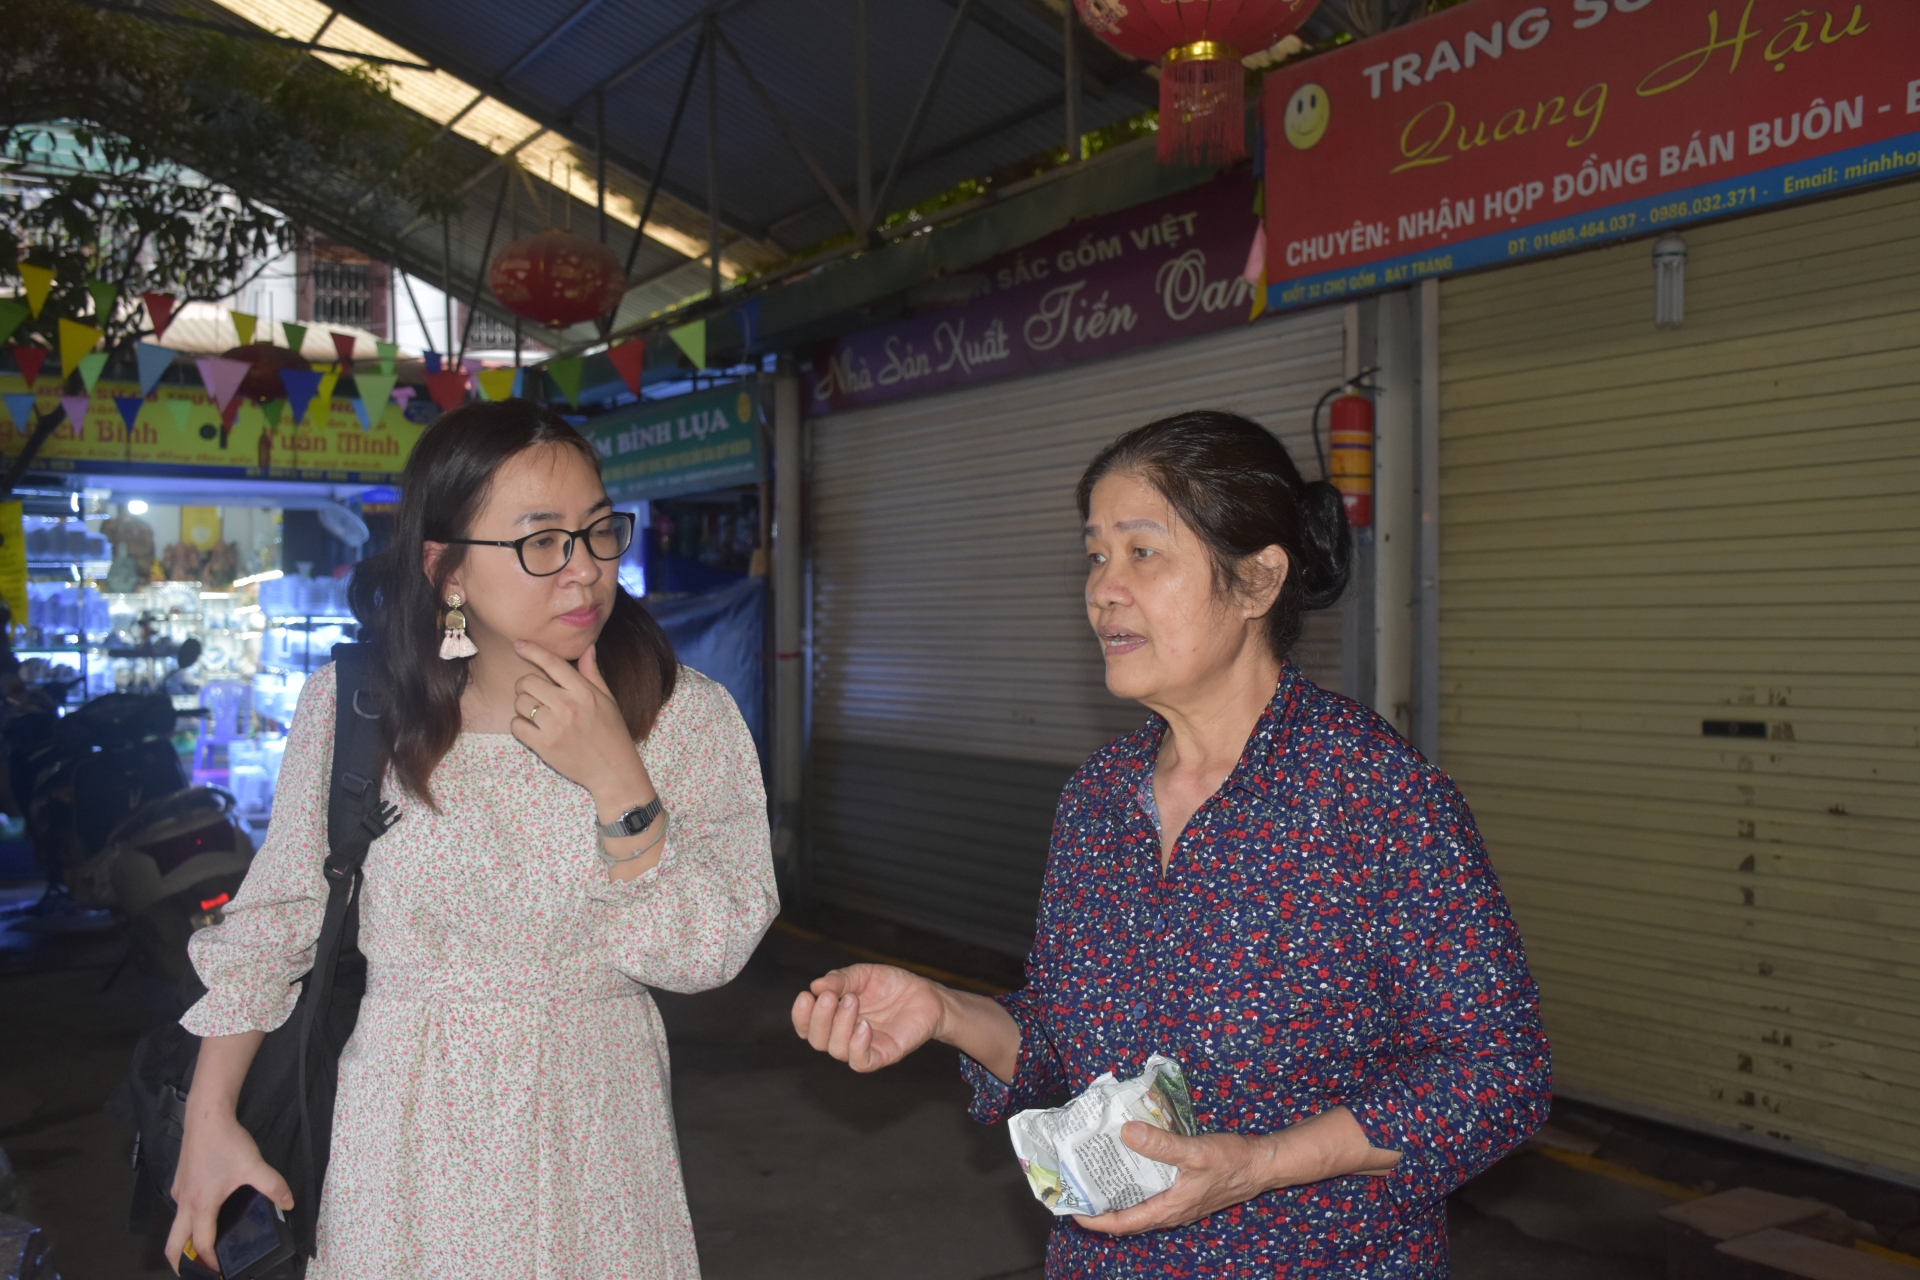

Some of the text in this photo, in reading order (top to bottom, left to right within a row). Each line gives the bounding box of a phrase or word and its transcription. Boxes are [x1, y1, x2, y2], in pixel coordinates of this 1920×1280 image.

[1362, 7, 1551, 99] TRANG
[1390, 0, 1871, 174] Quang Hậu
[1286, 219, 1390, 267] CHUYÊN:
[1398, 197, 1475, 240] NHẬN
[1483, 180, 1544, 224] HỢP
[1552, 153, 1648, 203] ĐỒNG
[1659, 130, 1735, 177] BÁN
[1747, 95, 1863, 156] BUÔN
[1784, 166, 1839, 194] Email:
[1056, 232, 1123, 273] GỐM
[1129, 211, 1198, 250] VIỆT
[934, 318, 1010, 376] Xuất
[1023, 279, 1138, 351] Tiến
[676, 407, 729, 442] LỤA
